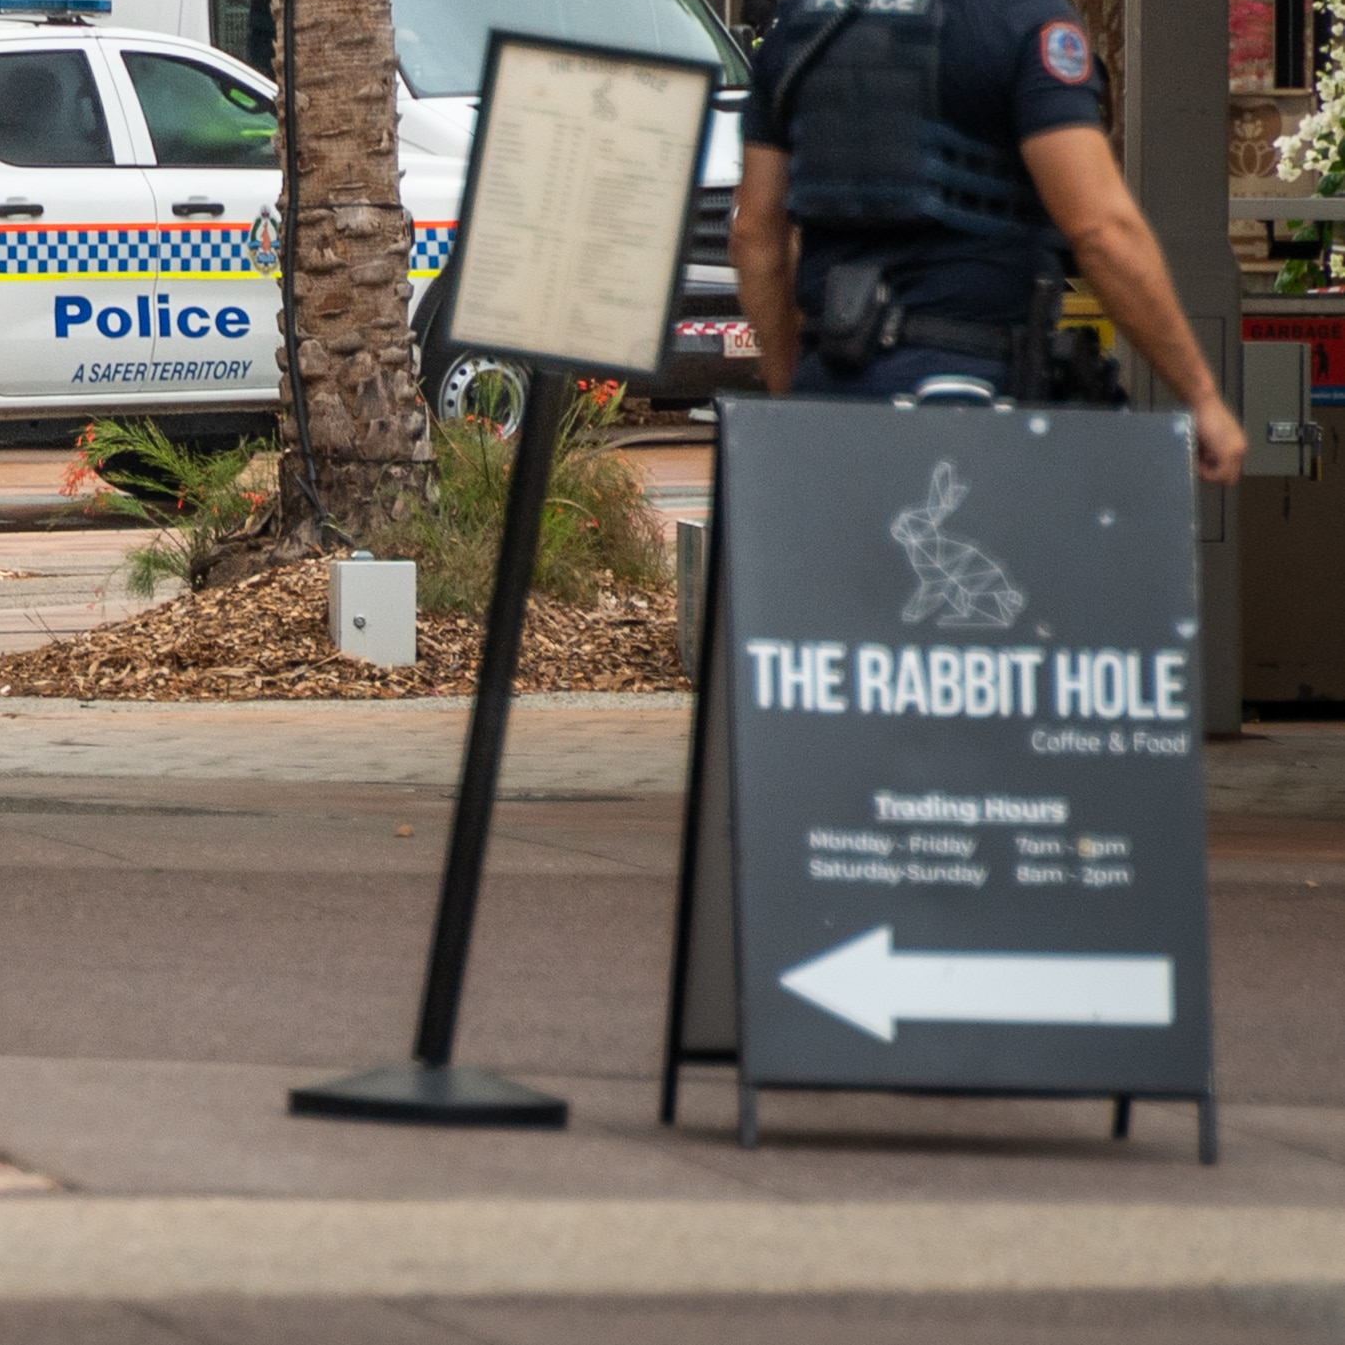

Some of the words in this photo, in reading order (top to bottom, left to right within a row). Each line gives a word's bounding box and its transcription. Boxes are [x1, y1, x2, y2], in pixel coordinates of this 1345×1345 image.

[54, 294, 251, 338] Police
[1250, 324, 1342, 339] GARBAGE
[71, 364, 84, 383] A
[89, 362, 148, 383] SAFER
[150, 360, 253, 381] TERRITORY
[745, 640, 847, 712] THE
[856, 643, 1044, 718] RABBIT
[1053, 646, 1188, 720] HOLE
[1031, 731, 1101, 753] Coffee
[1109, 731, 1125, 752] &
[1133, 732, 1186, 754] Food
[874, 795, 977, 825] Trading
[984, 797, 1067, 823] Hours
[809, 833, 894, 856] Monday
[910, 835, 977, 858] Friday
[1016, 865, 1063, 884] 8am
